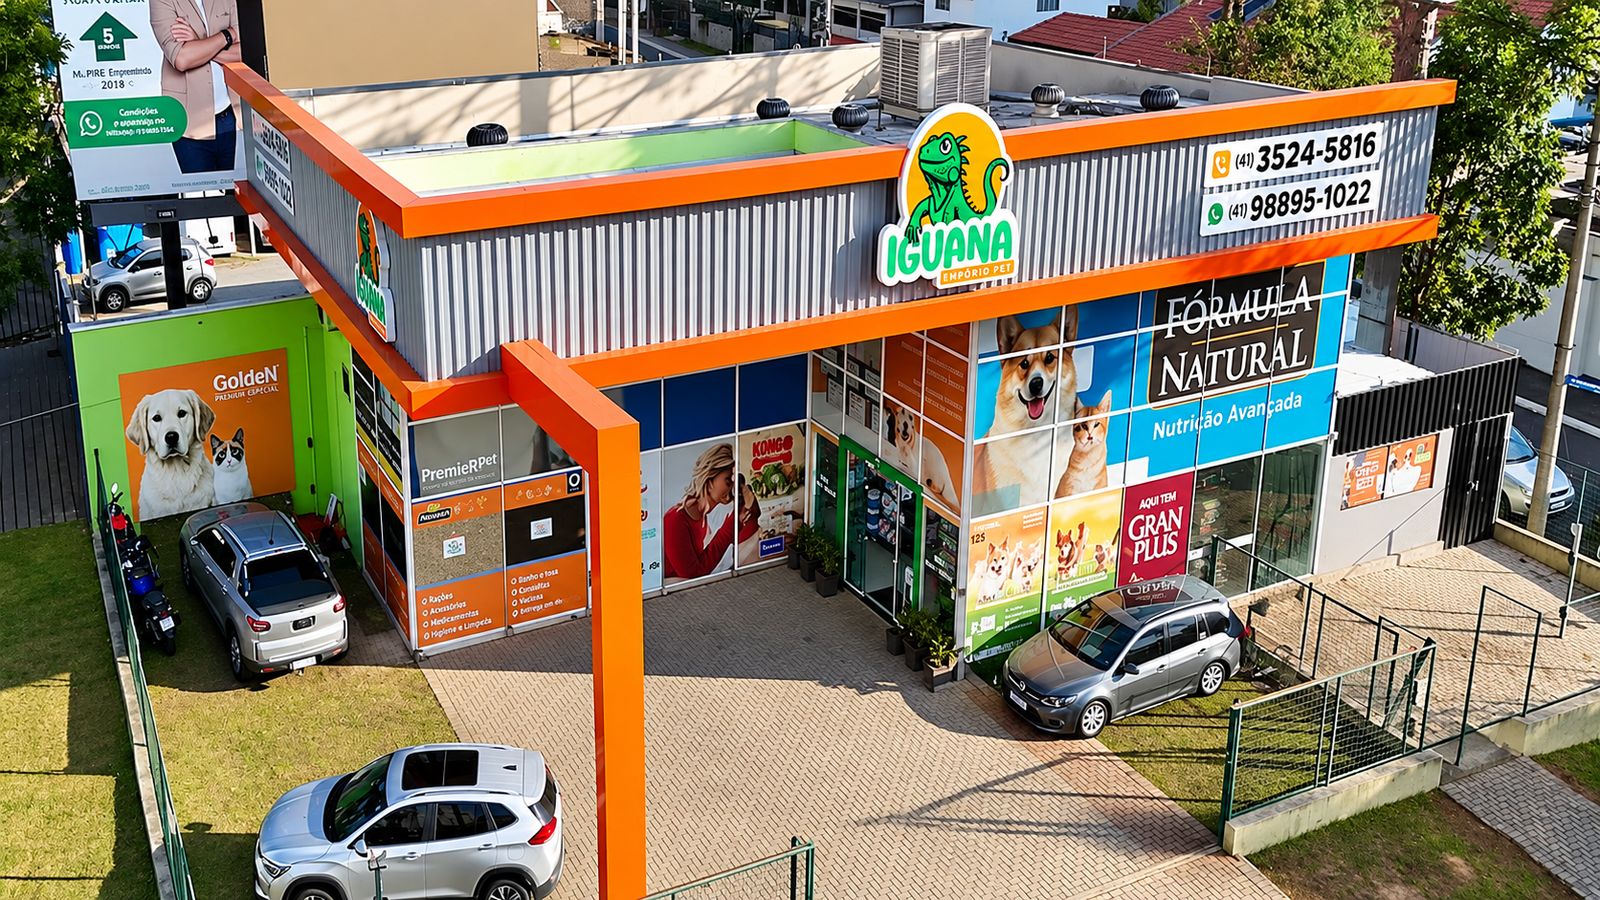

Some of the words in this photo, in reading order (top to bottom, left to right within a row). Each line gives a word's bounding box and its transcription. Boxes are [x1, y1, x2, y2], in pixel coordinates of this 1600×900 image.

[102, 27, 114, 44] 5
[101, 80, 125, 89] 2018
[1235, 152, 1254, 170] (41)
[1256, 131, 1377, 172] 3524-5816
[1228, 203, 1247, 220] (41)
[1250, 179, 1371, 221] 98895-1022
[887, 221, 1012, 278] IGUANA
[943, 268, 990, 282] EMPÓRIO
[993, 263, 1012, 274] PET
[1164, 275, 1312, 339] FÓRMULA
[1158, 328, 1308, 396] NATURAL
[1153, 411, 1222, 440] Nutrição
[1227, 391, 1302, 424] Avançada
[1139, 495, 1159, 510] AQUI
[1160, 491, 1177, 504] TEM
[1128, 506, 1184, 541] GRAN
[1132, 531, 1179, 565] PLUS
